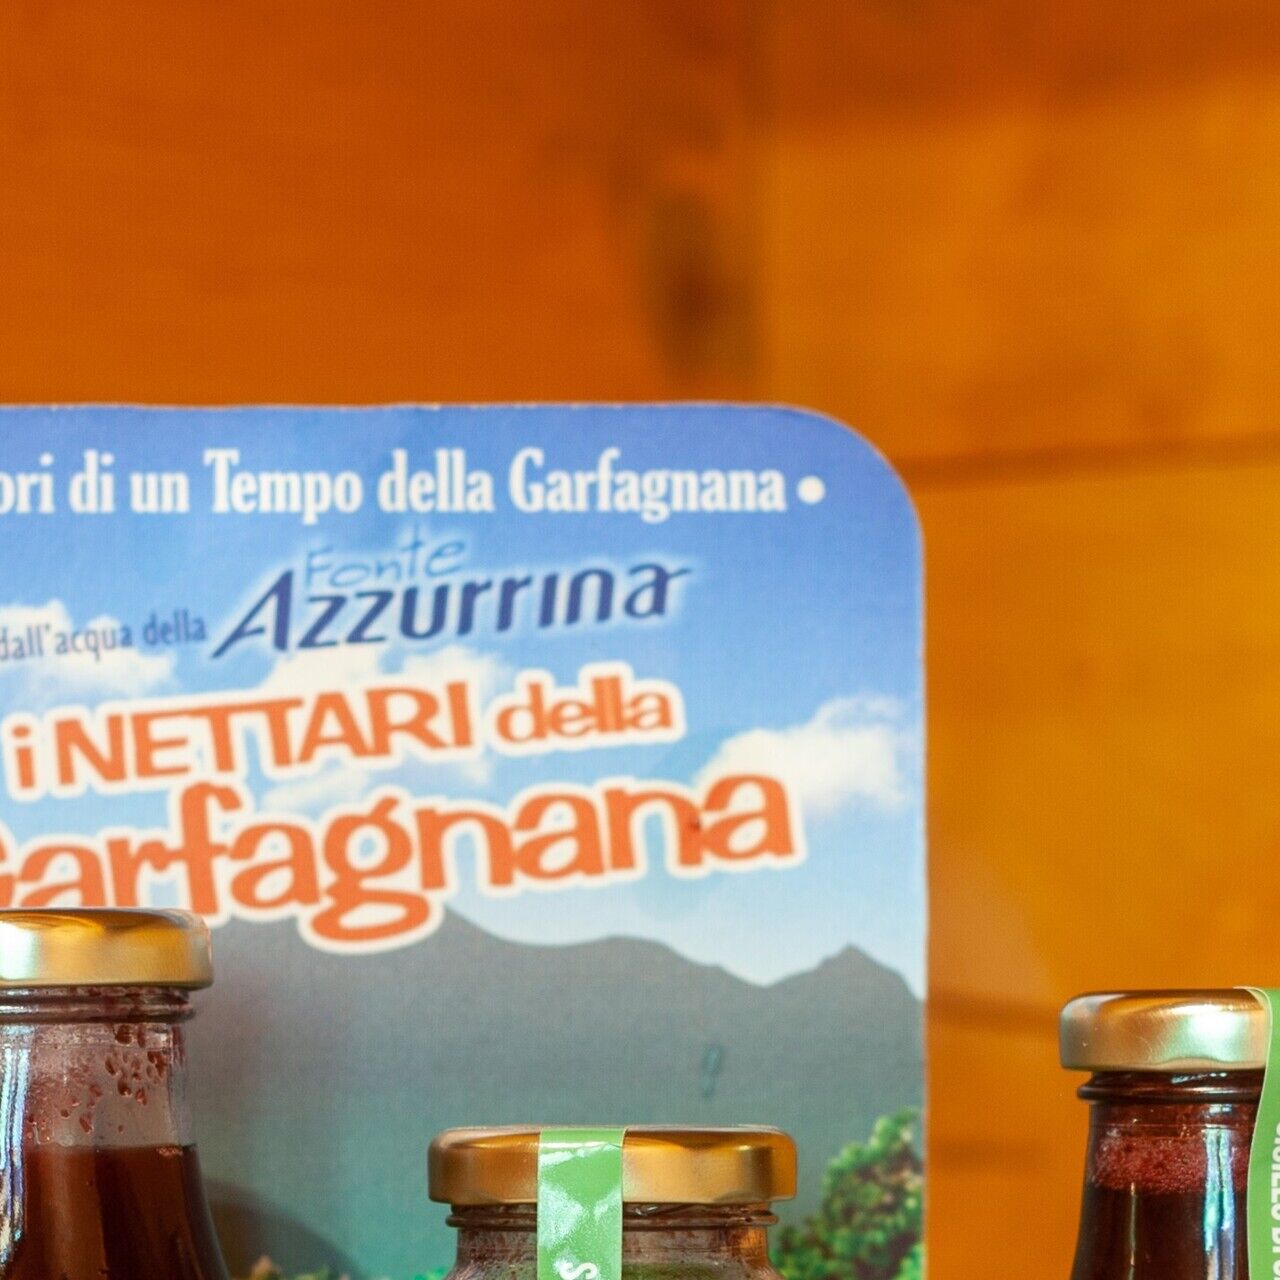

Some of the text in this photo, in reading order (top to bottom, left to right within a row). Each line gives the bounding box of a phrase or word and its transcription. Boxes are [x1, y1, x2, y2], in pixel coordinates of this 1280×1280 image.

[69, 448, 115, 514] di
[130, 472, 190, 514] un
[203, 449, 363, 525] Tempo
[378, 448, 495, 514] della
[509, 447, 787, 524] Garfagnana
[304, 524, 465, 589] Fonte
[144, 610, 207, 646] della
[13, 676, 673, 789] i NETTARI della
